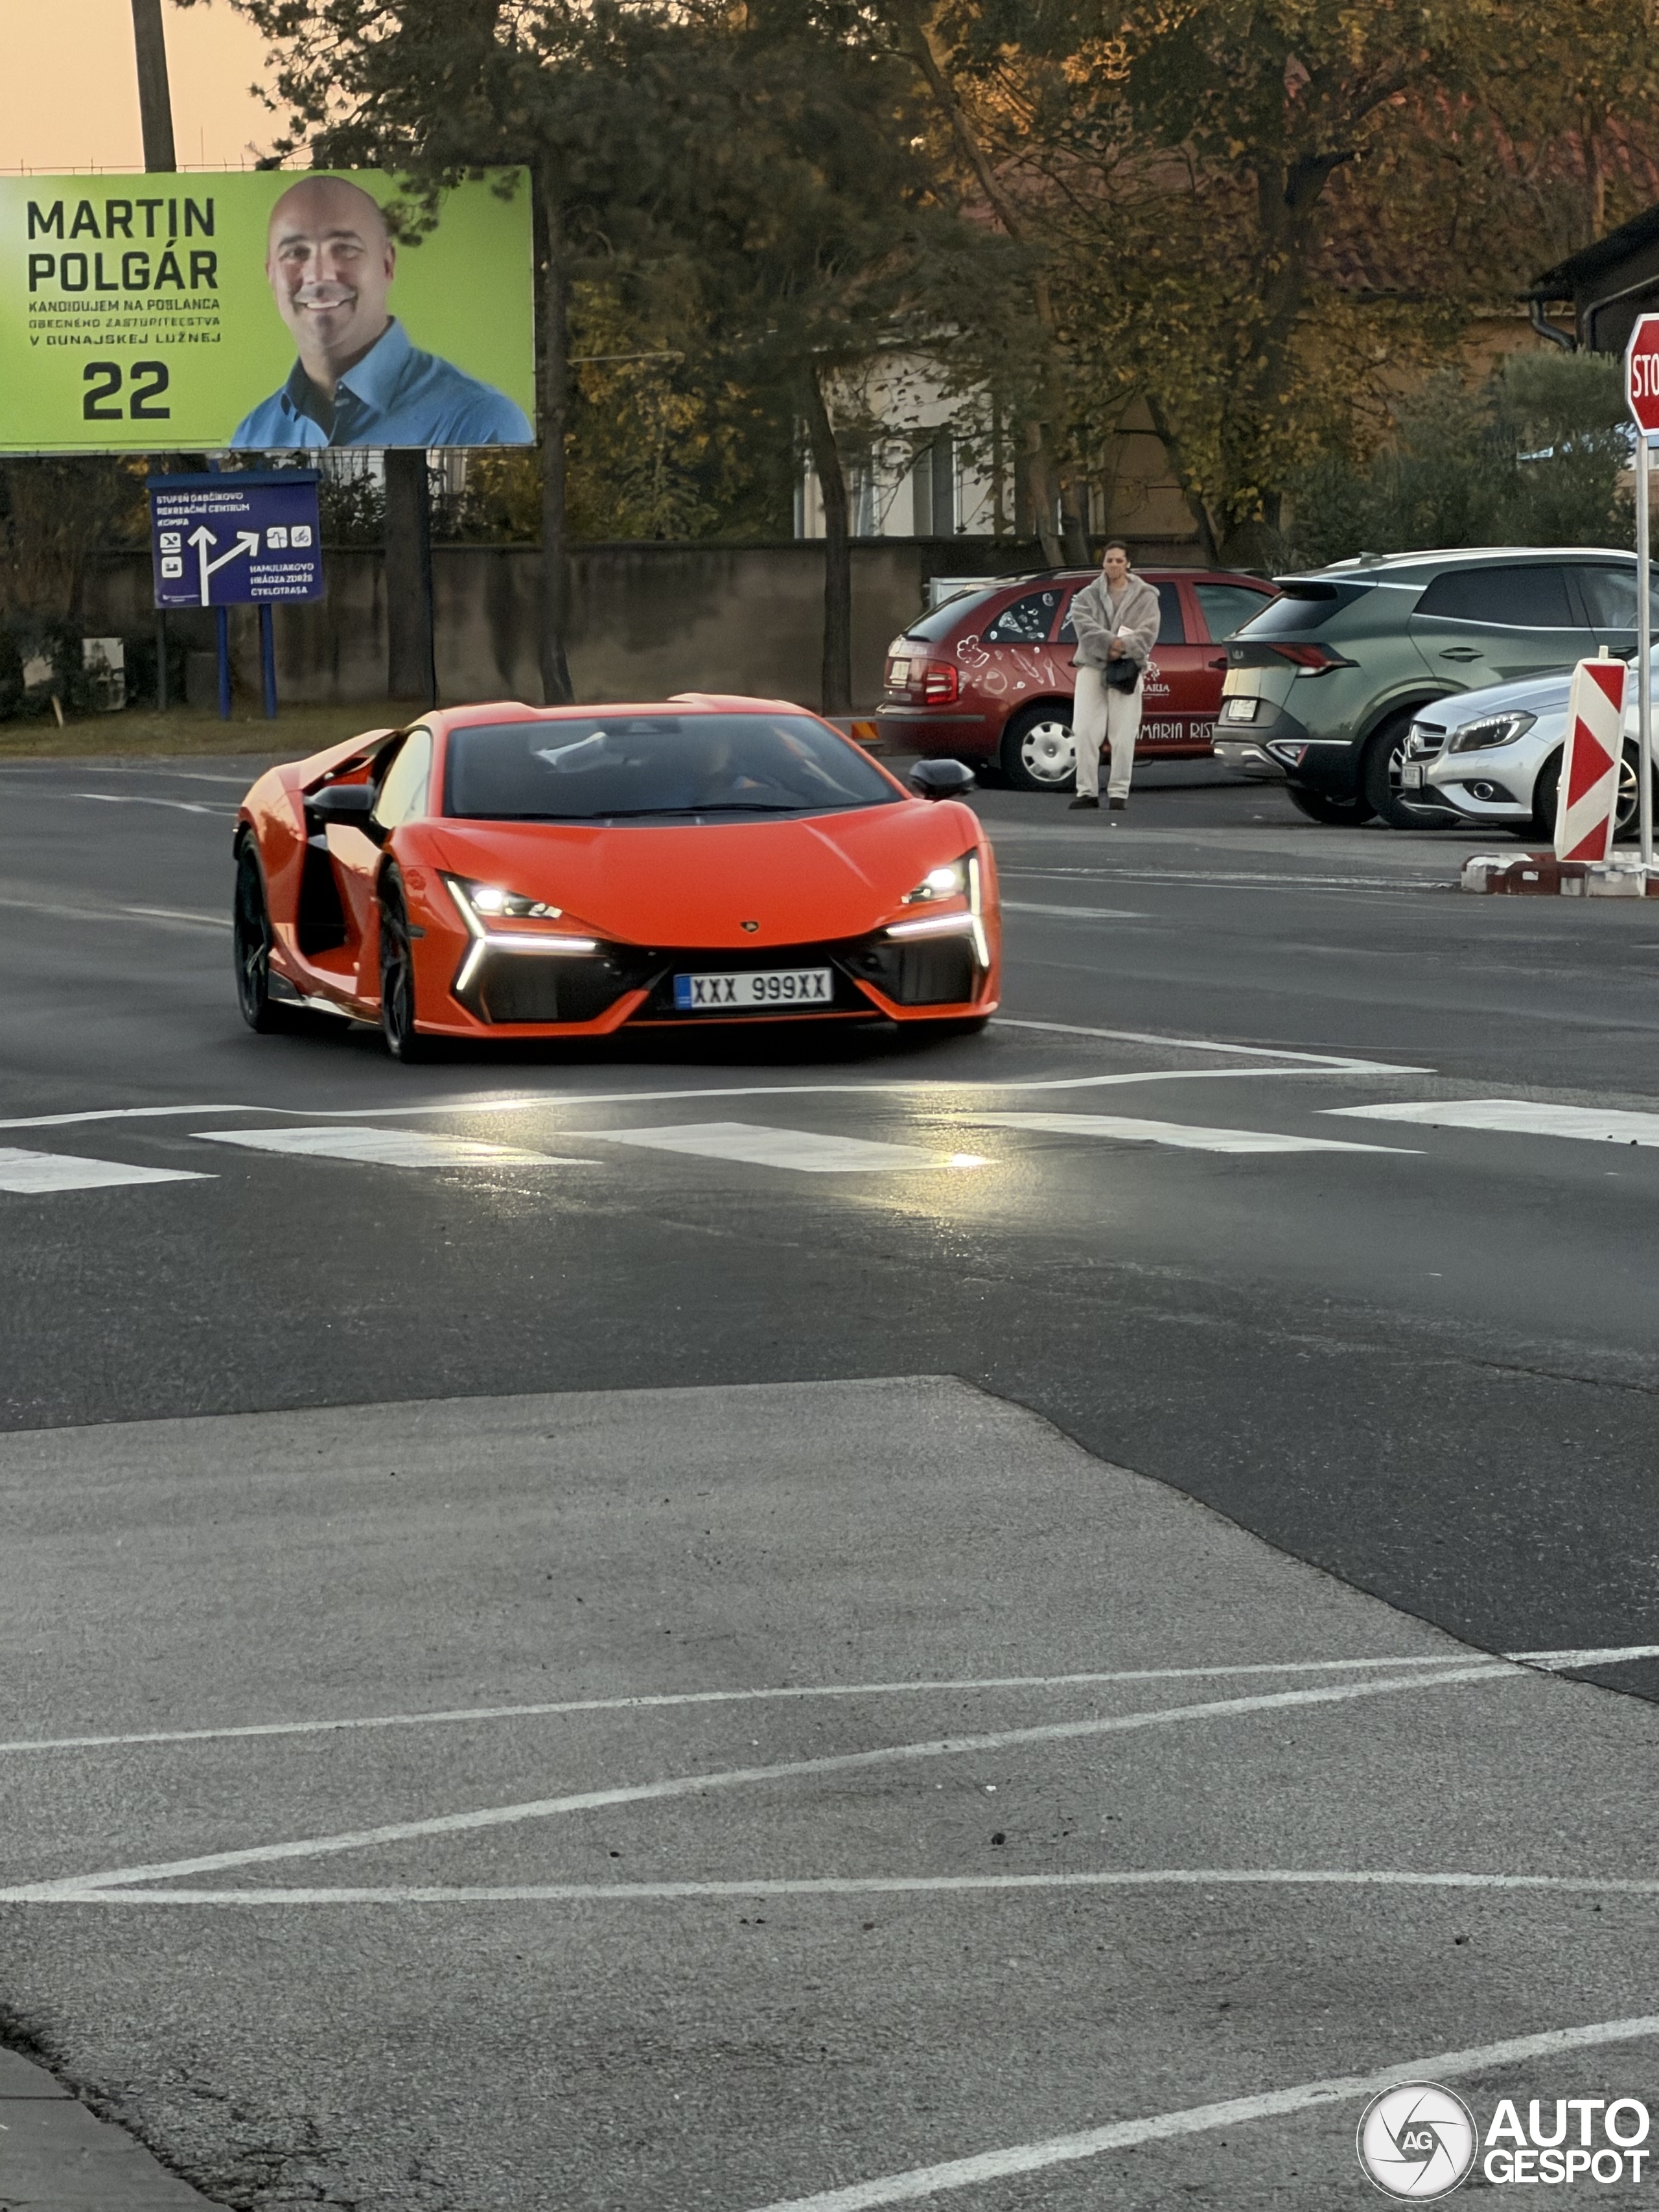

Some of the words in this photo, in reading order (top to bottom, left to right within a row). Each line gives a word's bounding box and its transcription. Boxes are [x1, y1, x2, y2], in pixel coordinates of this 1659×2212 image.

[27, 198, 215, 240] MARTIN
[28, 240, 218, 292] POLGÁR
[29, 300, 119, 312] KANDIDUJEM
[124, 299, 143, 310] NA
[147, 298, 220, 310] POSLANCA
[30, 335, 40, 345] V
[47, 332, 148, 345] DUNAJSKEJ
[156, 331, 221, 343] LUŽNEJ
[83, 360, 170, 421] 22
